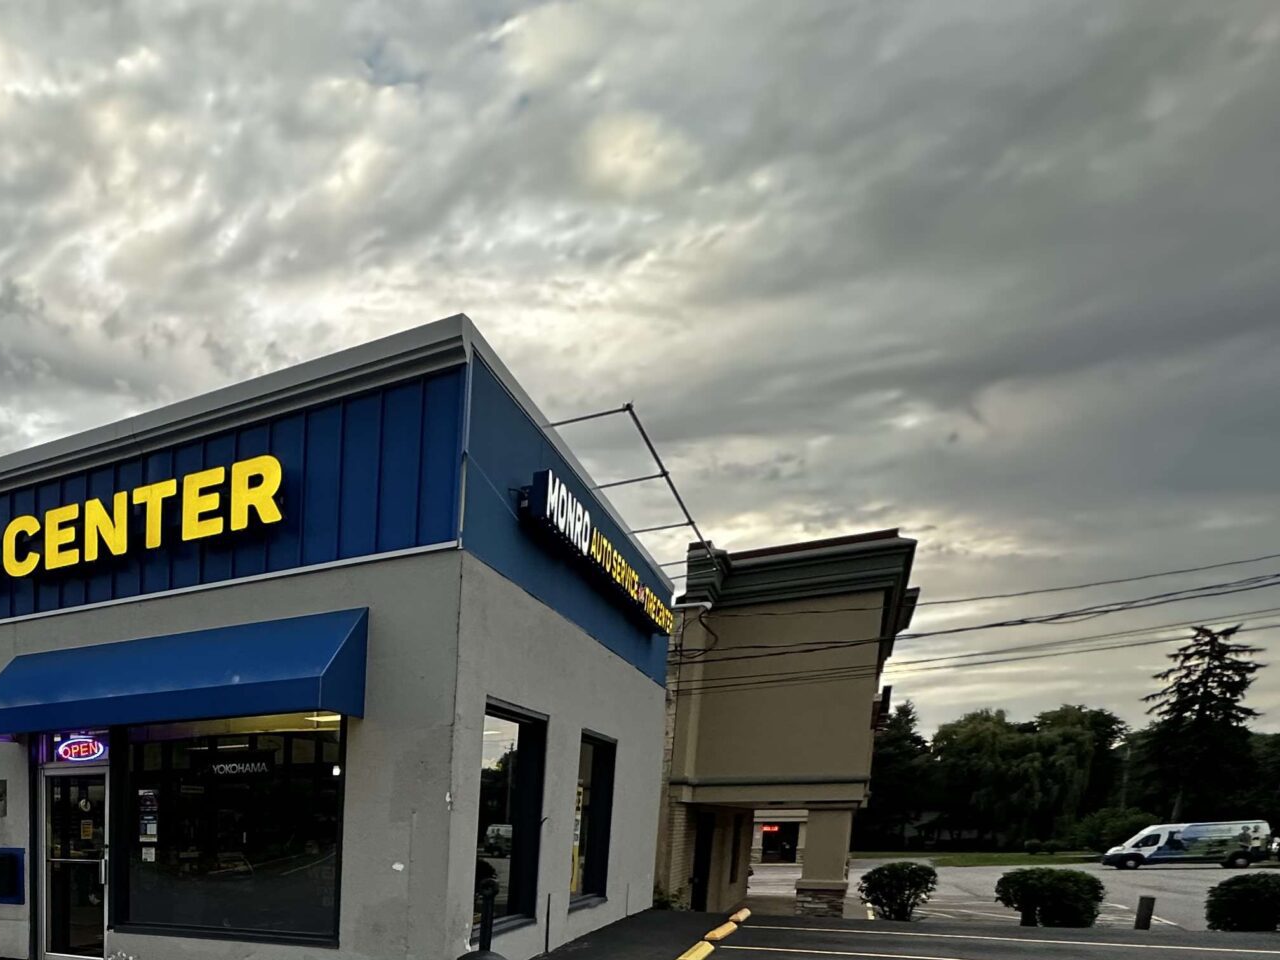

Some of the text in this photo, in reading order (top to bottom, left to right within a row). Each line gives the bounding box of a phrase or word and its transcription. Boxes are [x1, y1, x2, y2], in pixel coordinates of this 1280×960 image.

[2, 454, 283, 578] CENTER
[546, 469, 591, 556] MONRO
[590, 526, 613, 573] AUTO
[612, 549, 639, 601] SERVICE
[61, 741, 98, 759] OPEN
[212, 762, 269, 774] YOKOHAMA
